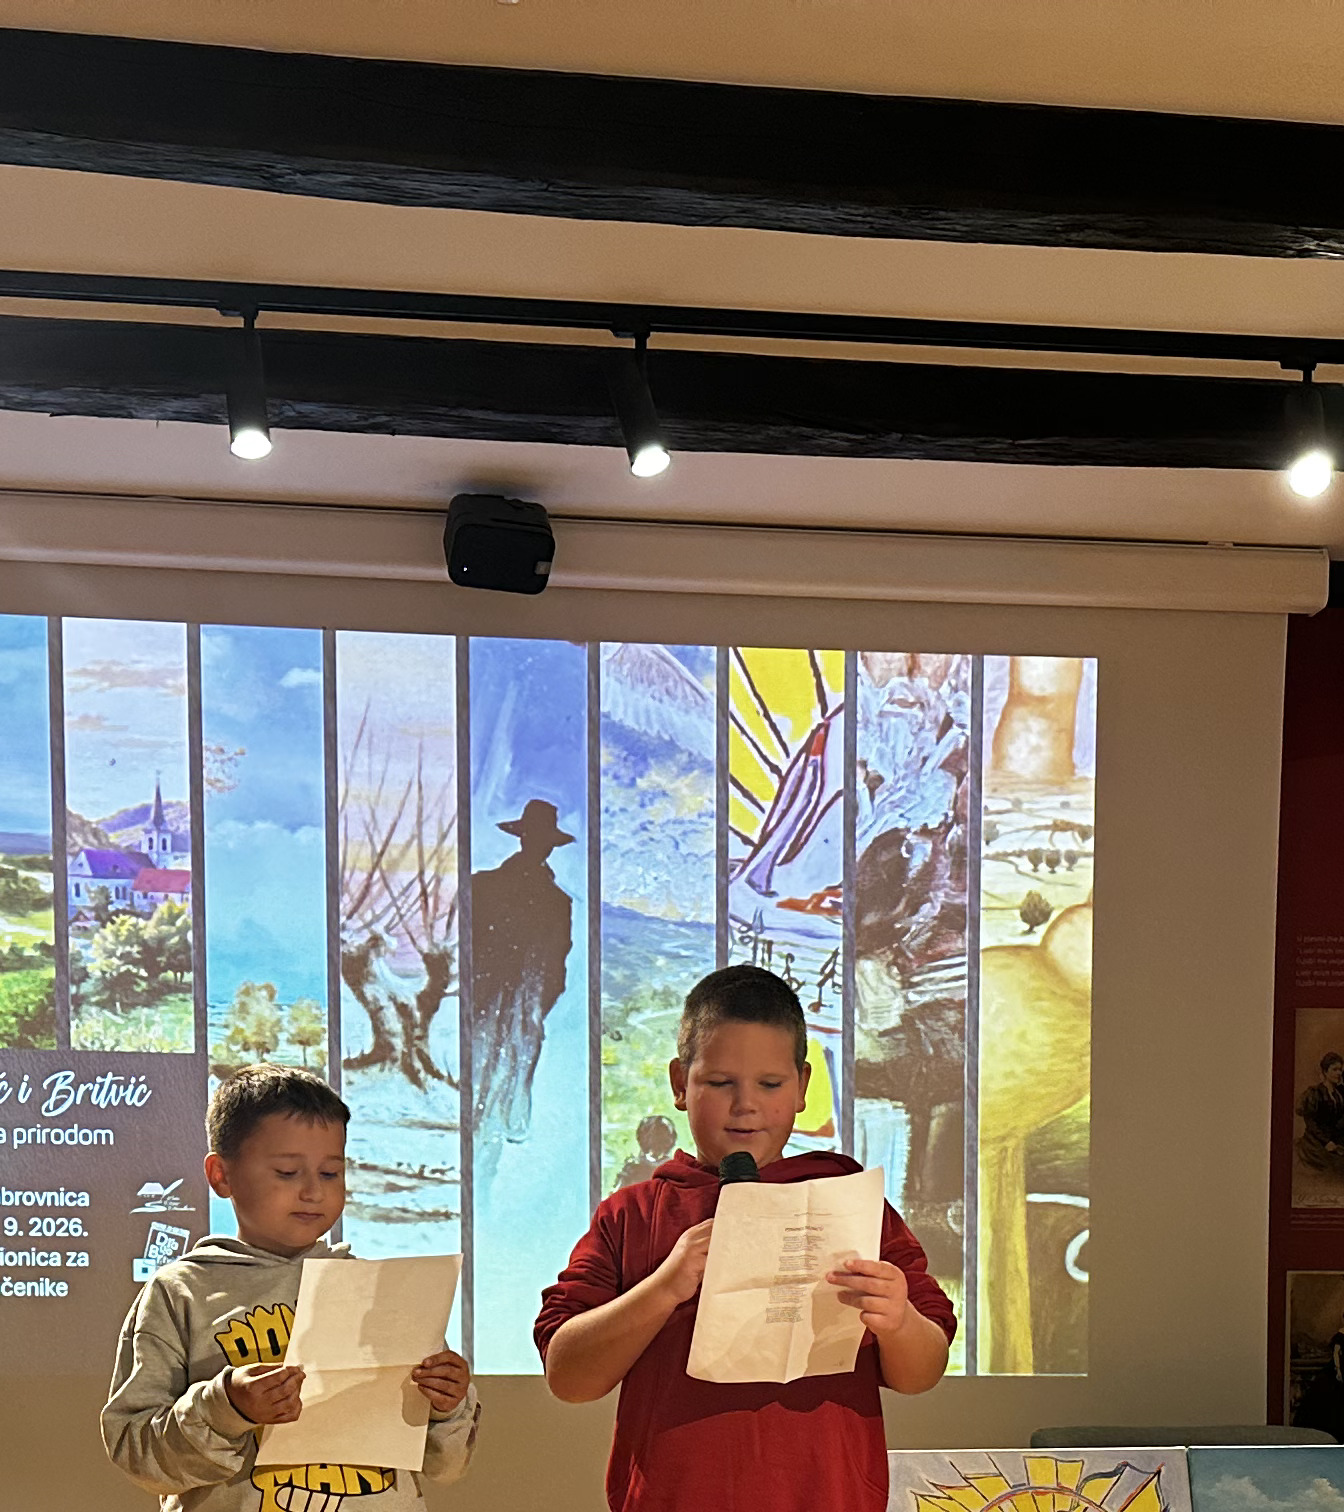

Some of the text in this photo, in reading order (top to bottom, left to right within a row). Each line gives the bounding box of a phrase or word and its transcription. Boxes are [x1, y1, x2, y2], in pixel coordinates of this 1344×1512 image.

[18, 1075, 33, 1104] i
[41, 1070, 153, 1118] Britvić
[12, 1123, 115, 1150] prirodom
[3, 1216, 25, 1237] 9.
[28, 1216, 89, 1237] 2026.
[65, 1252, 90, 1268] za
[214, 1303, 295, 1365] DO
